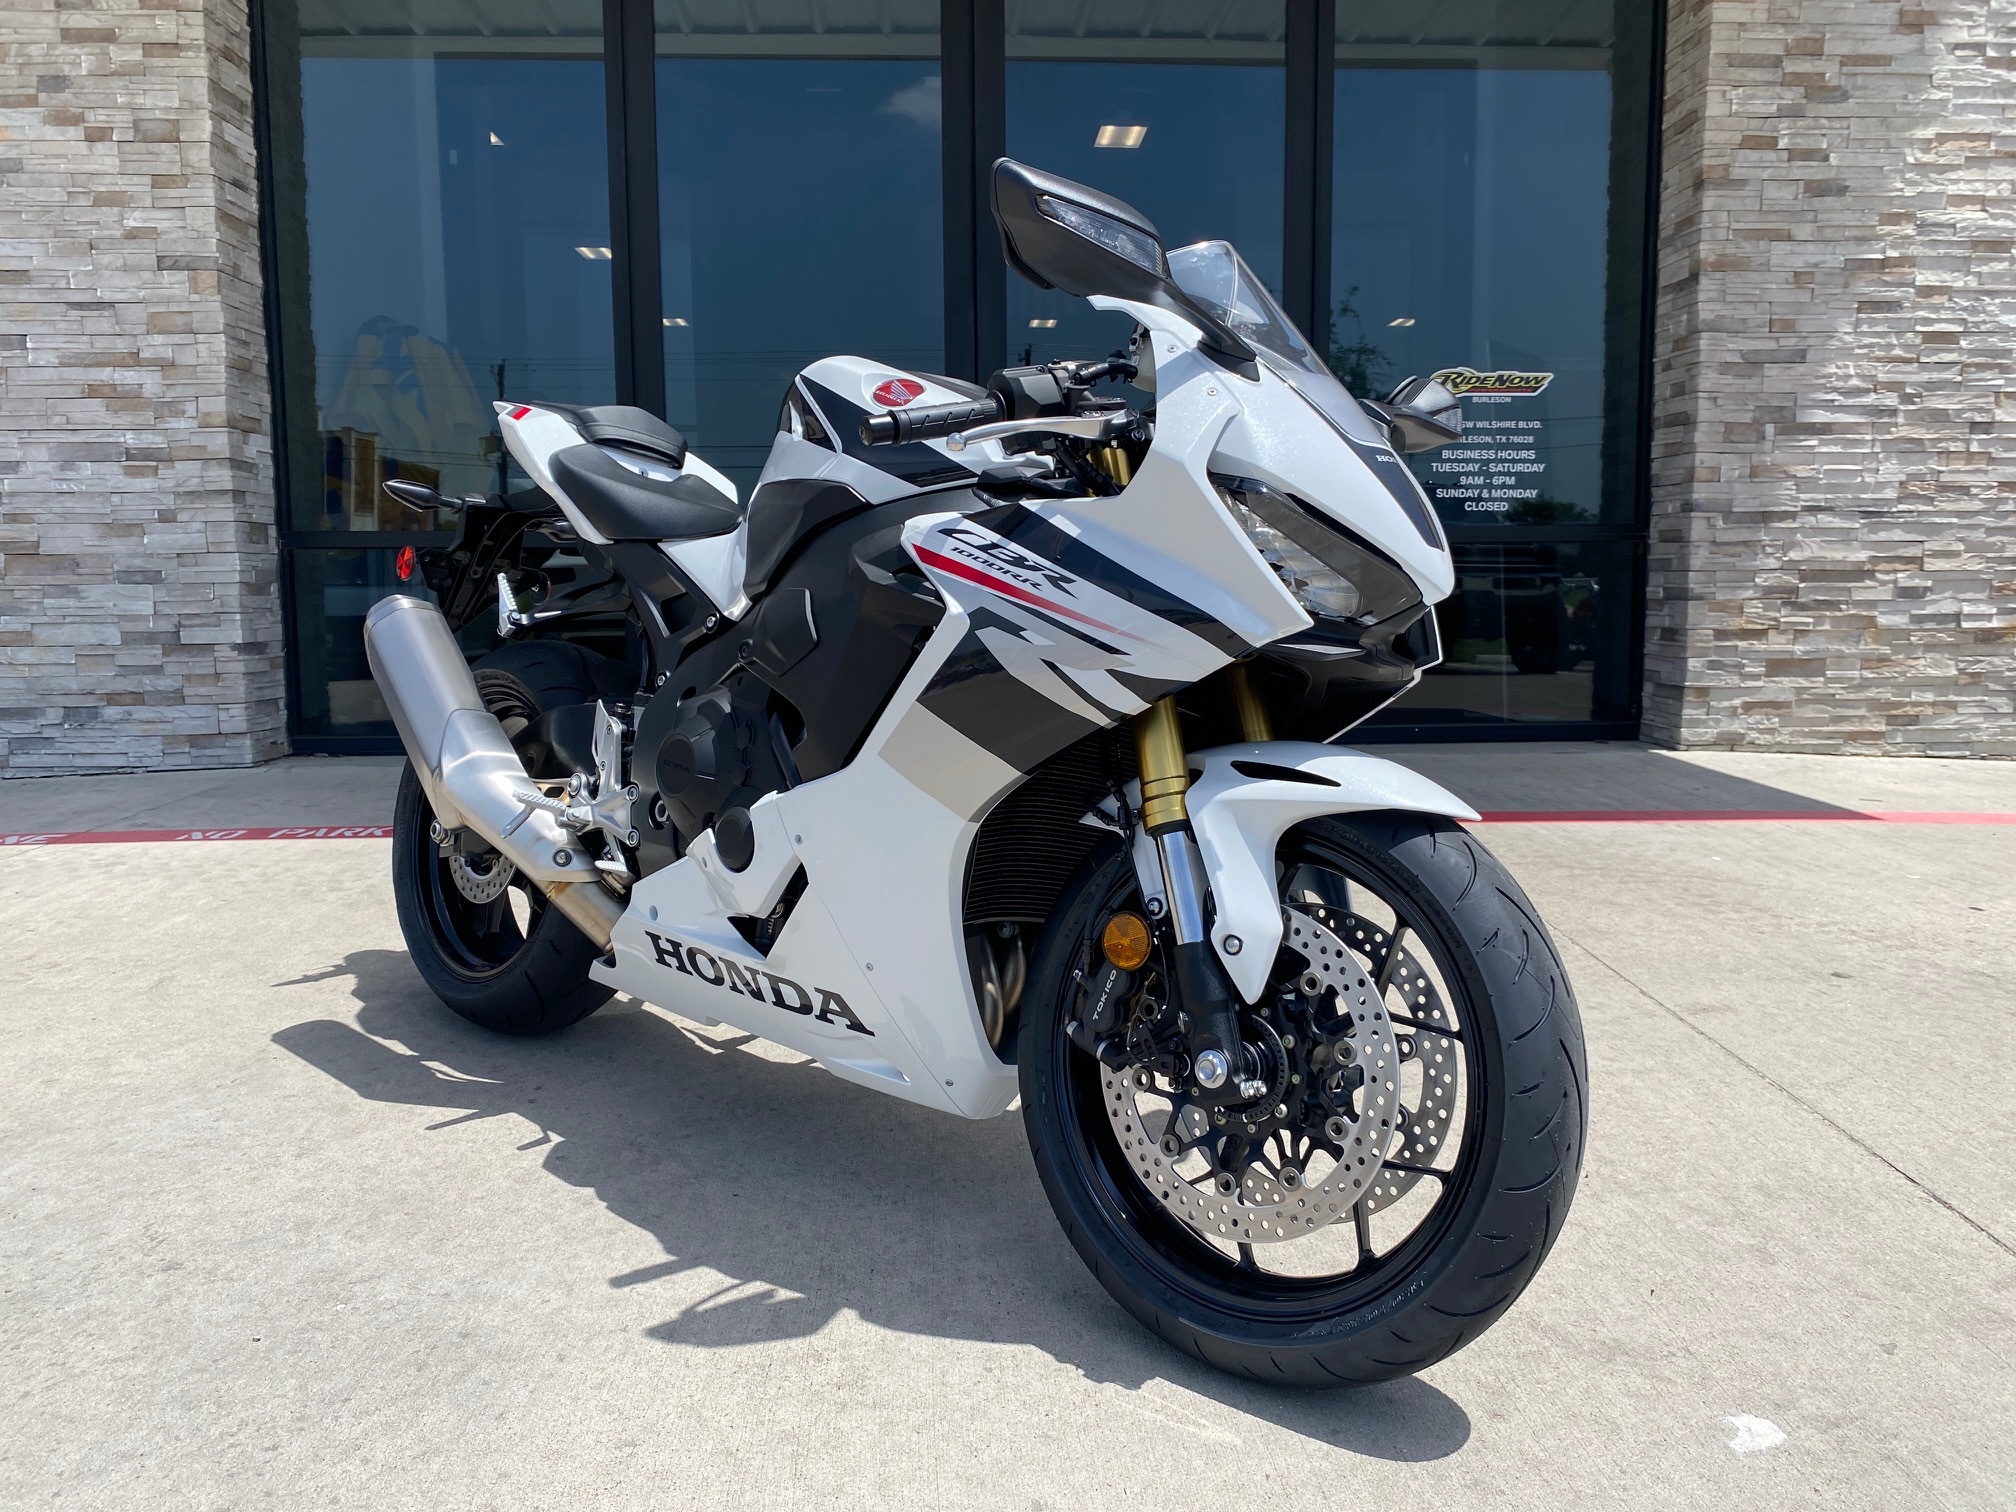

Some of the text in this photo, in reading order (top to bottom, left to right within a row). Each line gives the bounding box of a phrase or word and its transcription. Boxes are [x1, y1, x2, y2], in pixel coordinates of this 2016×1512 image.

[1476, 421, 1516, 429] WILSHIRE
[1518, 421, 1542, 429] BLVD.
[1442, 450, 1536, 459] BUSINESS HOURS
[1431, 463, 1480, 472] TUESDAY
[1489, 463, 1545, 472] SATURDAY
[1460, 476, 1483, 485] 9AM
[1492, 476, 1515, 485] 6PM
[1436, 489, 1538, 498] SUNDAY & MONDAY
[1464, 502, 1508, 511] CLOSED
[937, 528, 1079, 600] CBR
[951, 546, 1043, 592] 1000RR
[175, 829, 249, 840] NO
[644, 929, 876, 1037] HONDA
[1092, 969, 1117, 1021] TOKICO
